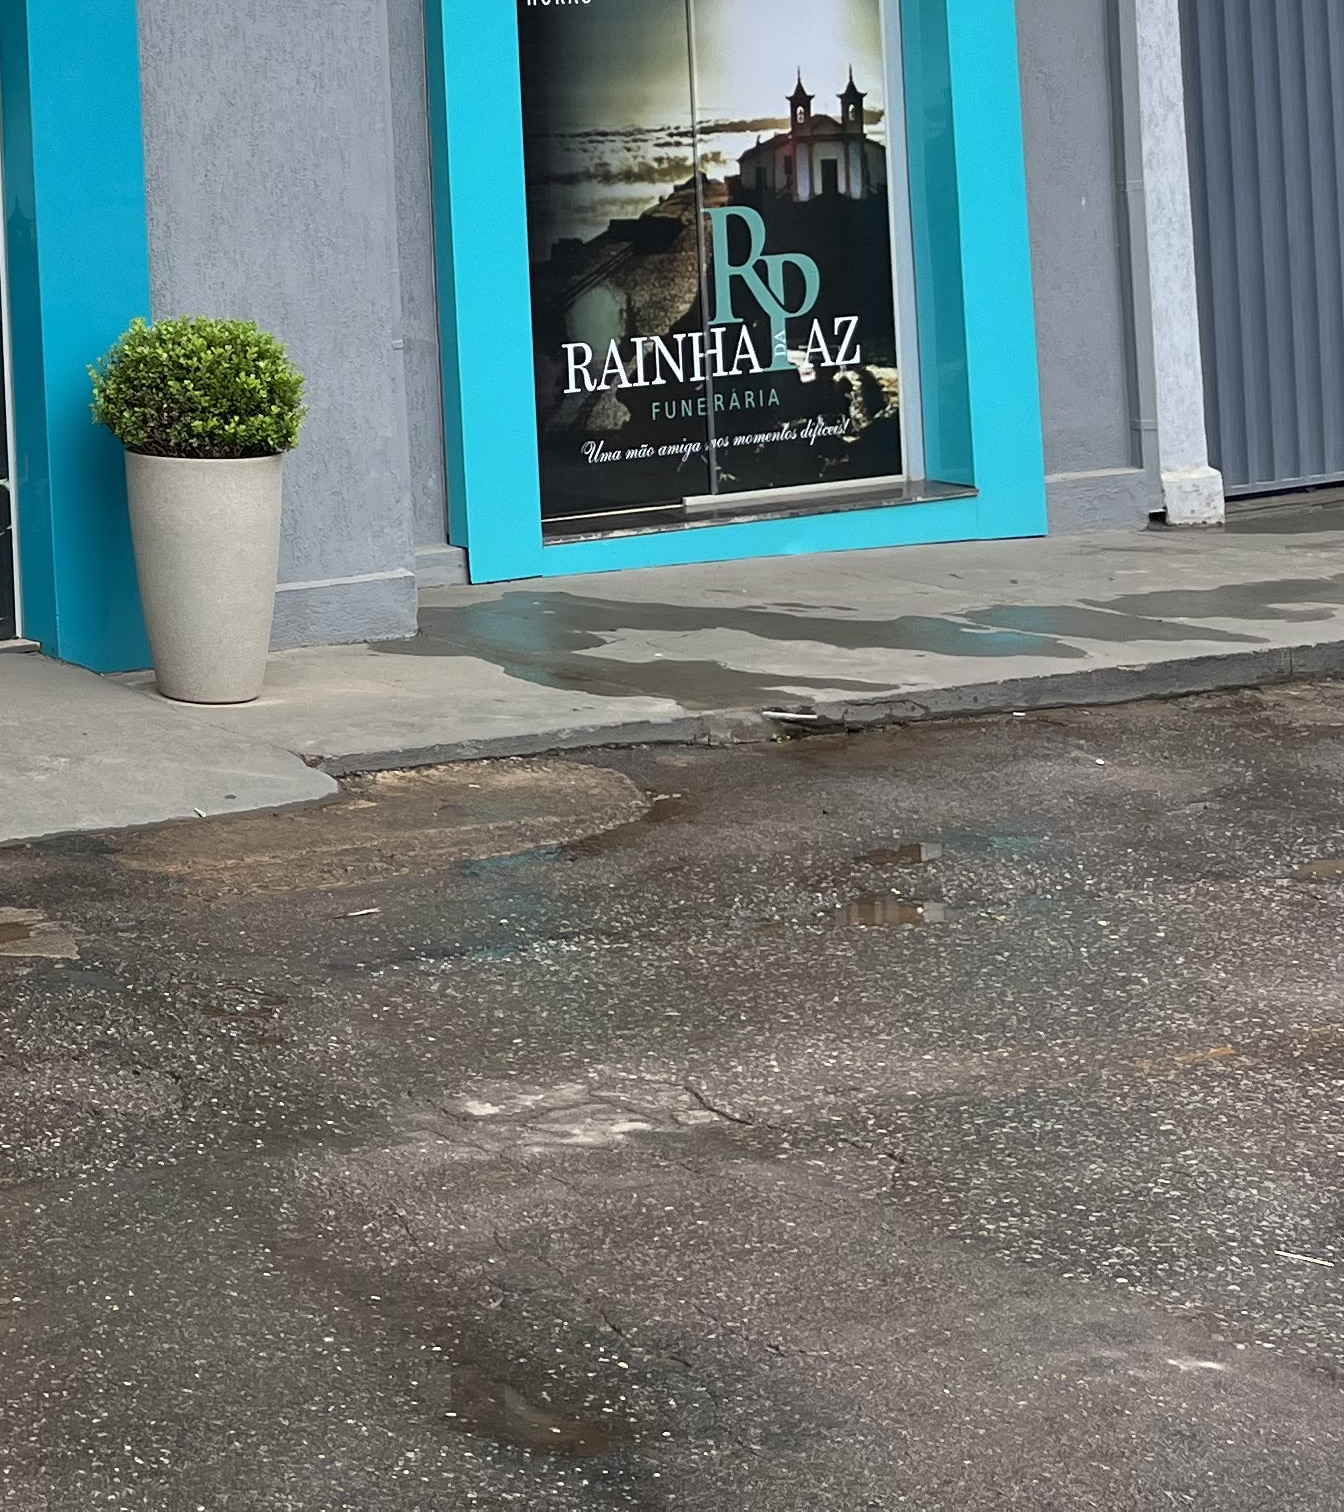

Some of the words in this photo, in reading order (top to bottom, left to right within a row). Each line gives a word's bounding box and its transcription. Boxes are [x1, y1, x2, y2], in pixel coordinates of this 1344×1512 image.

[562, 324, 763, 394] RAINHA
[651, 388, 780, 420] FUNERÁRIA
[580, 439, 621, 464] Uma
[625, 443, 655, 460] mão
[657, 437, 701, 463] amiga
[733, 422, 797, 447] momentos
